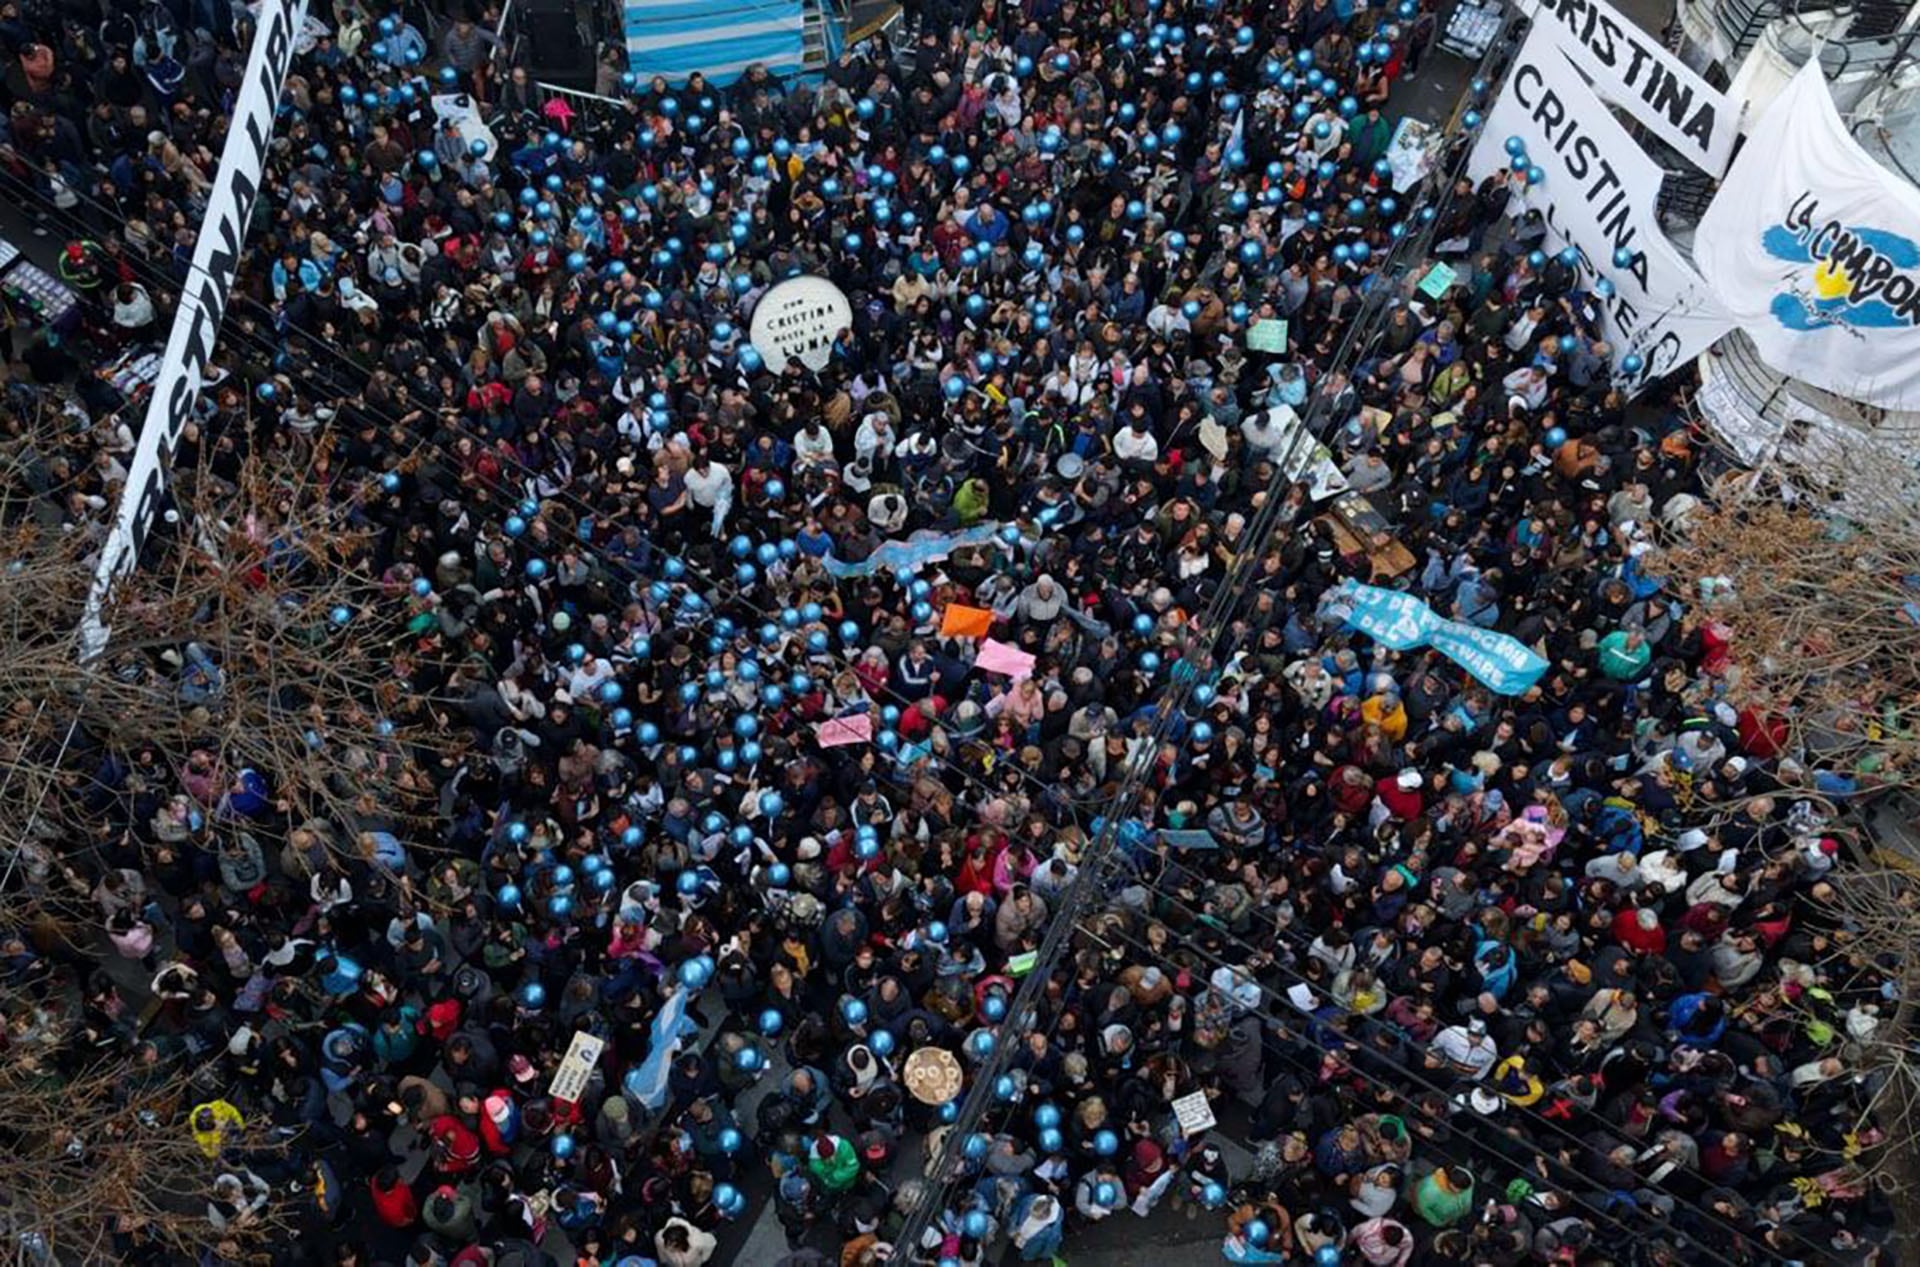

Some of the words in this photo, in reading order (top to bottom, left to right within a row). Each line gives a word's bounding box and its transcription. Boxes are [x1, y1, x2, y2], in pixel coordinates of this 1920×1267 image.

[1539, 0, 1715, 152] RISTINA
[1513, 64, 1648, 294] CRISTINA
[1786, 190, 1819, 241] LA
[767, 304, 834, 330] CRISTINA
[782, 335, 830, 357] LUNA
